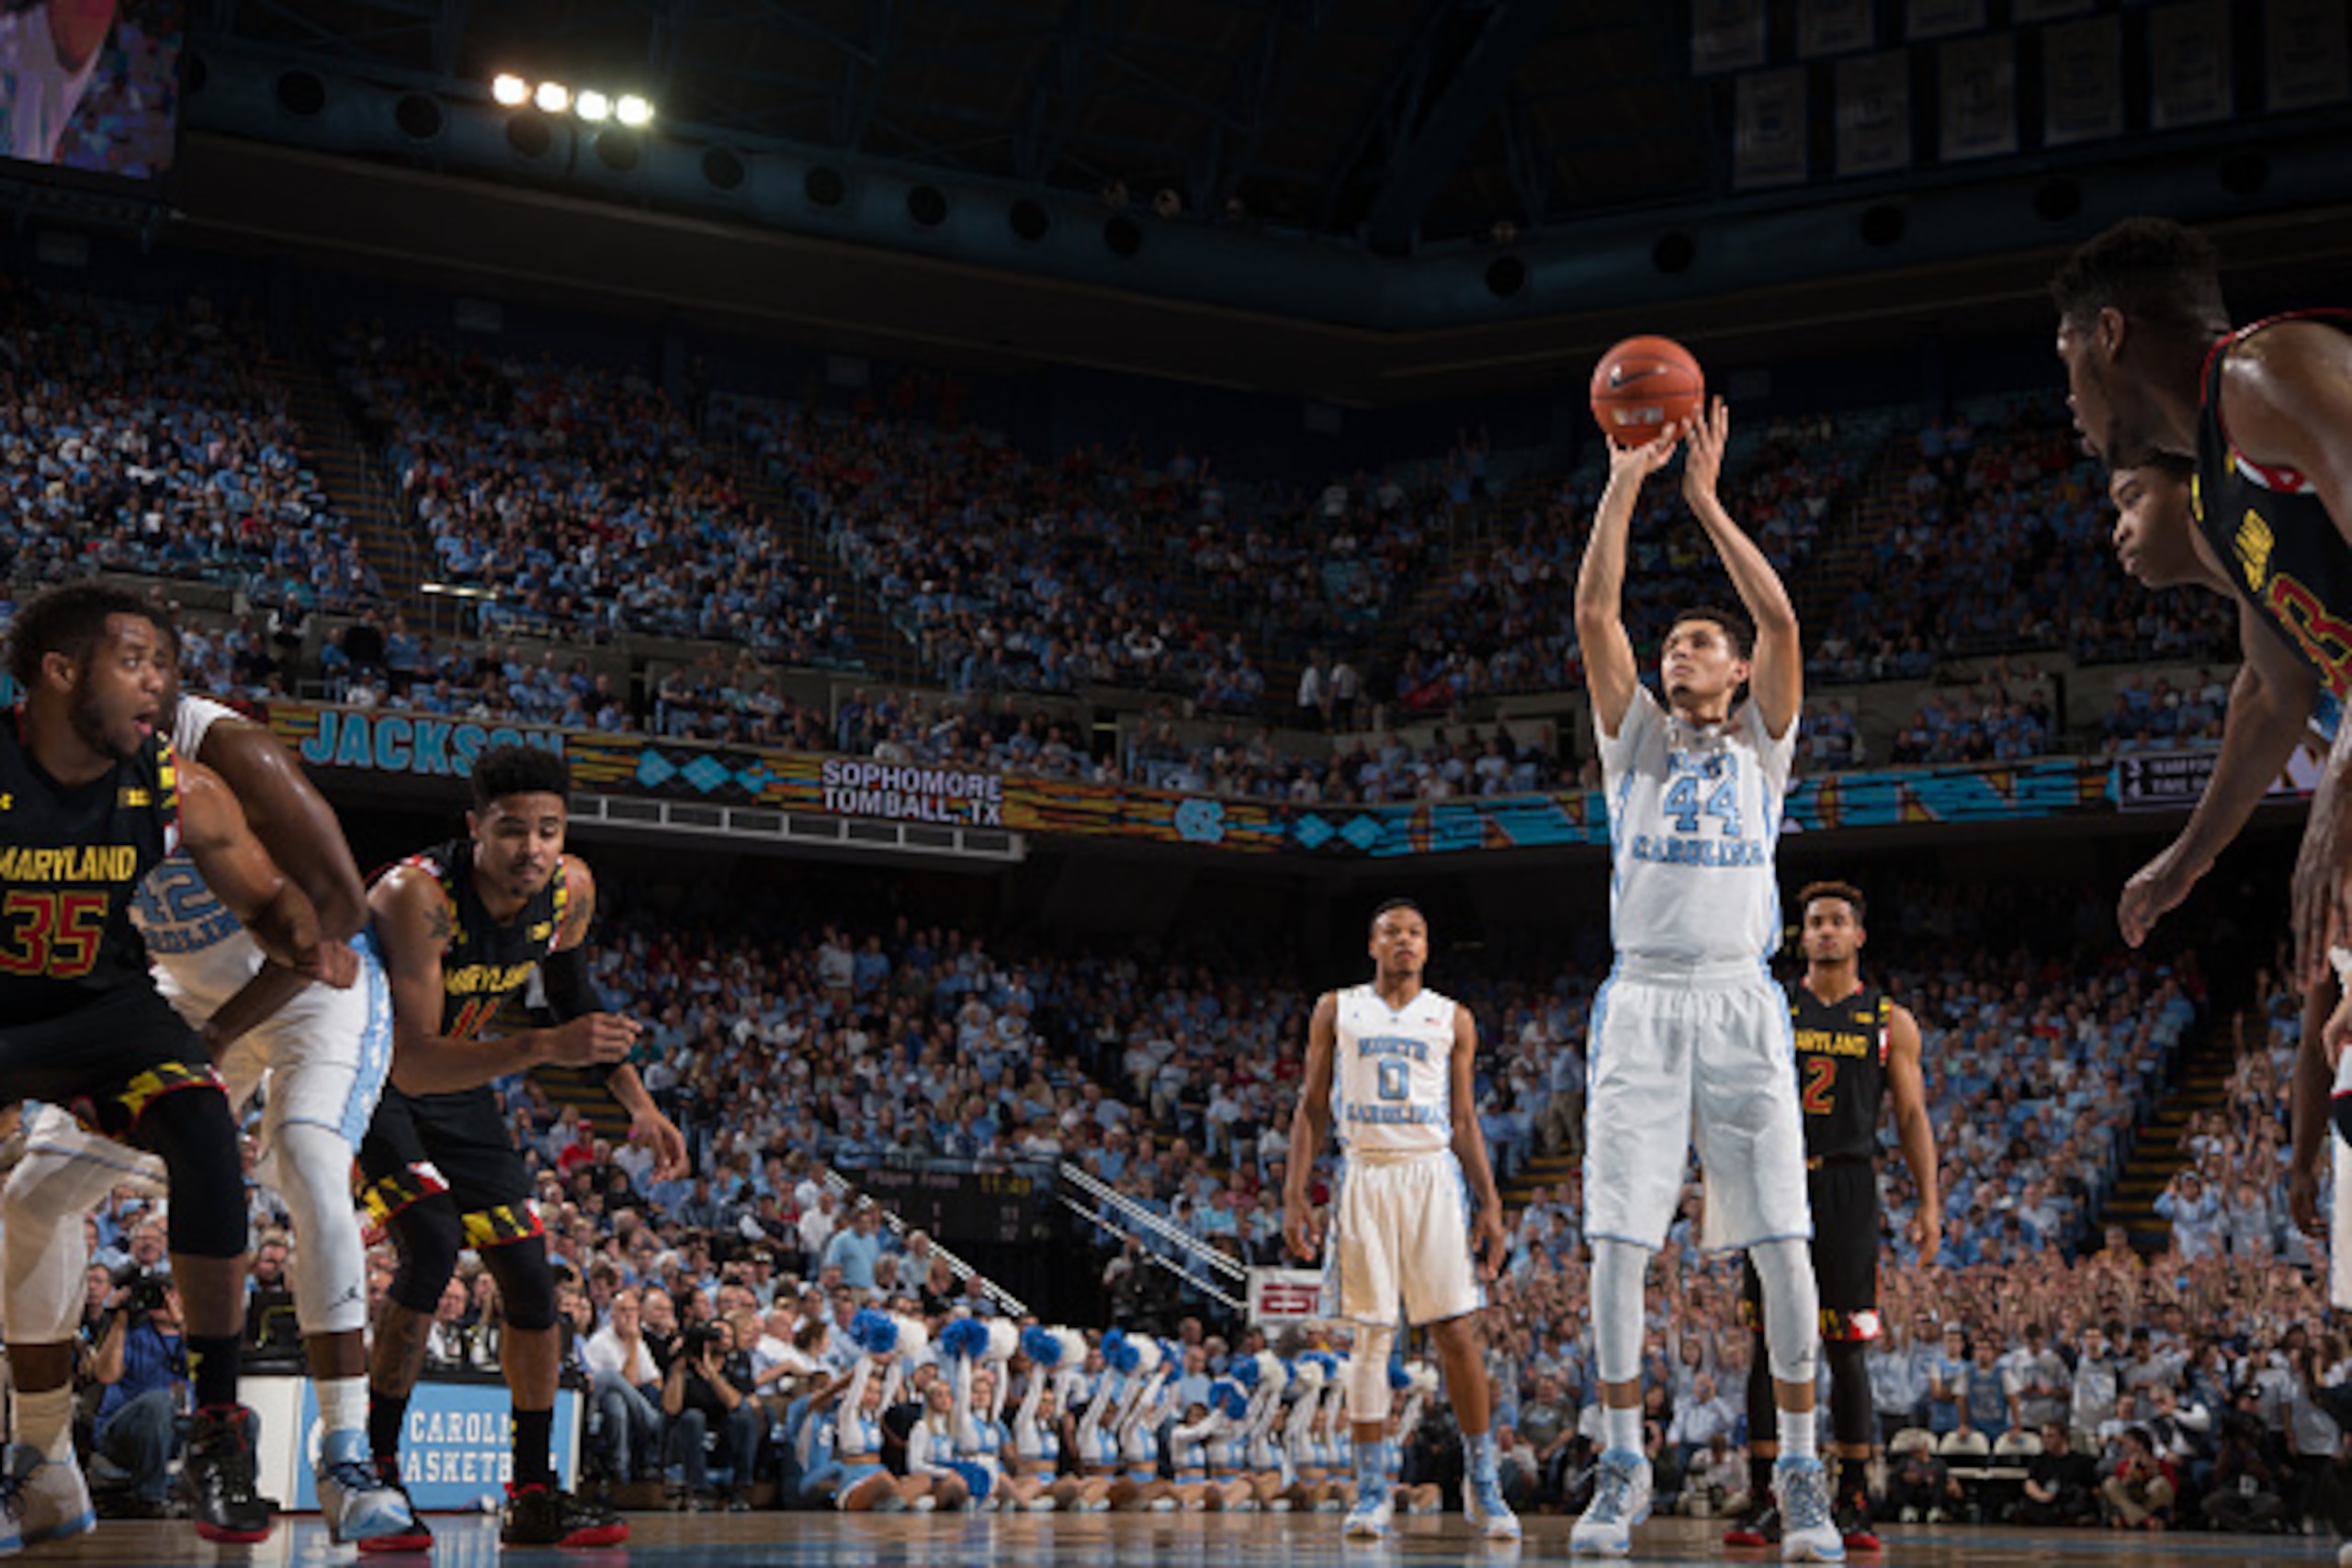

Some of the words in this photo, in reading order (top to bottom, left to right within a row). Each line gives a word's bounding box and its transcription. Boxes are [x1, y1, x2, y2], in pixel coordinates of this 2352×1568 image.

[299, 710, 564, 777] JACKS
[821, 760, 1003, 801] SOPHOMORE
[824, 784, 961, 824] TOMBALL,
[970, 798, 1001, 825] TX
[1663, 776, 1740, 836] 44
[1632, 833, 1765, 867] CAROLINA
[0, 888, 109, 978] 35
[1377, 1057, 1409, 1100] 0
[1803, 1055, 1837, 1115] 2
[411, 1411, 513, 1444] CAROLI
